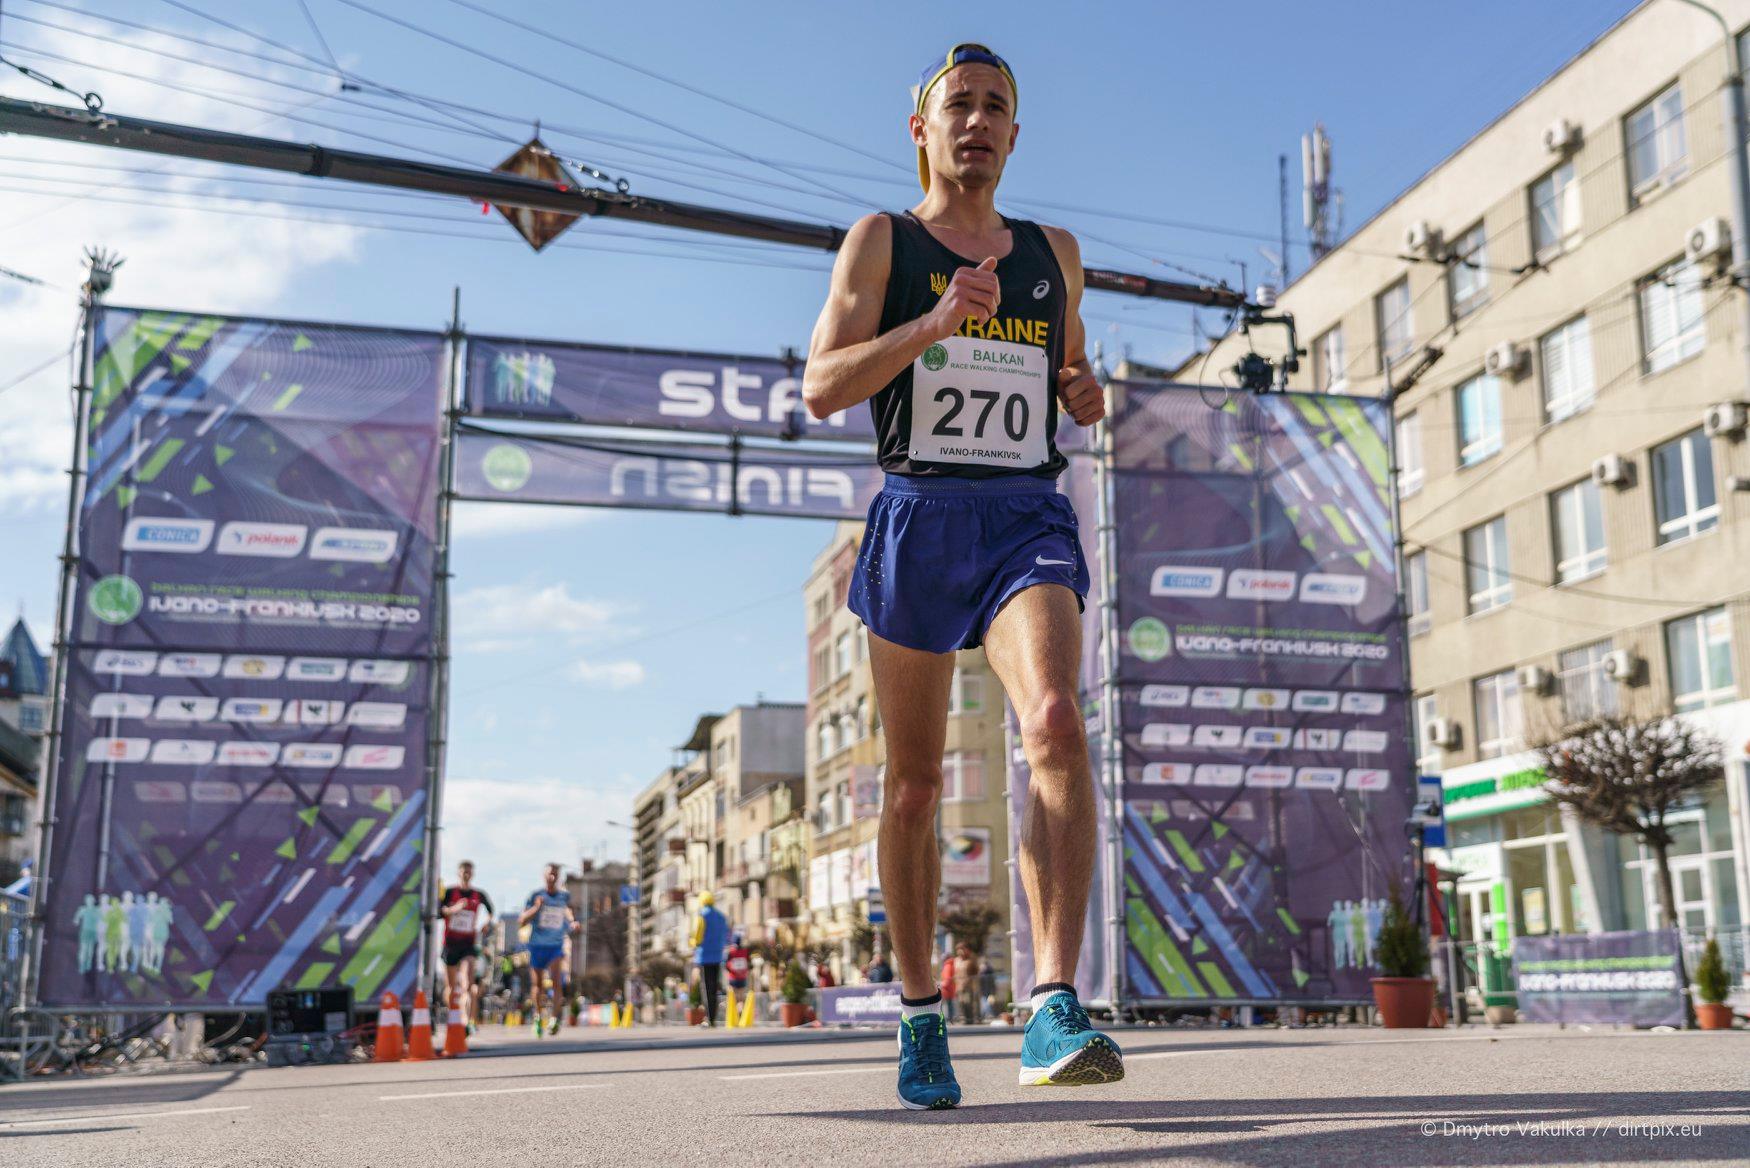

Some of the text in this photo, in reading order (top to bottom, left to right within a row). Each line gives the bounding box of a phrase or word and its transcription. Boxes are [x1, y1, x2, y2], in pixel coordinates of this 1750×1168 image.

[973, 349, 1024, 367] BALKAN
[969, 364, 997, 373] WALKING
[998, 366, 1041, 379] CHAMPIONSHIPS
[931, 387, 1030, 442] 270
[940, 447, 1022, 460] IVANO-FRANKIVSK
